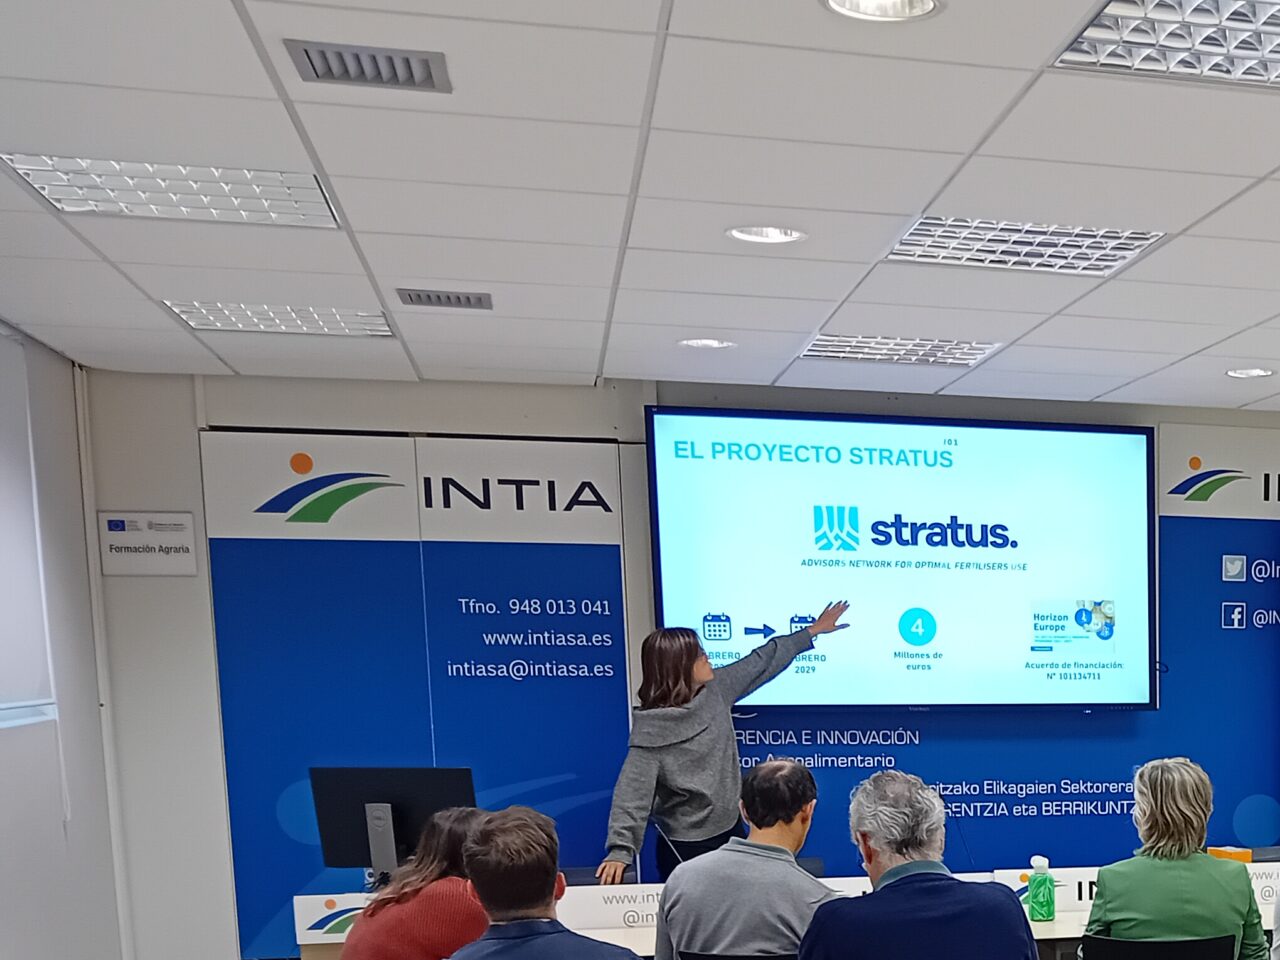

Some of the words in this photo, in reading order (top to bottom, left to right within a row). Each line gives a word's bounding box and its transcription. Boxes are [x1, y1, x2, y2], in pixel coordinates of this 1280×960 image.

[674, 441, 704, 459] EL
[711, 442, 842, 464] PROYECTO
[849, 447, 954, 468] STRATUS
[423, 477, 613, 512] INTIA
[870, 514, 1018, 548] stratus.
[109, 544, 156, 553] Formación
[158, 544, 190, 555] Agraria
[801, 559, 846, 568] ADVISORS
[849, 560, 892, 569] NETWORK
[895, 561, 912, 569] FOR
[915, 561, 951, 570] OPTIMAL
[955, 562, 1008, 571] FERTILISERS
[1011, 563, 1028, 571] USE
[458, 599, 500, 614] Tfno.
[509, 599, 541, 614] 948
[546, 599, 577, 615] 013
[581, 600, 611, 615] 041
[1033, 613, 1069, 622] Horizon
[911, 618, 925, 636] 4
[1033, 623, 1066, 632] Europe
[483, 630, 612, 646] www.intiasa.es
[894, 651, 930, 659] Millones
[447, 659, 614, 680] intiasa@intiasa.es
[795, 666, 816, 674] 2029
[802, 730, 812, 745] E
[817, 727, 920, 745] INNOVACIÓN
[983, 780, 1057, 798] Elikagaien
[1013, 803, 1038, 816] eta
